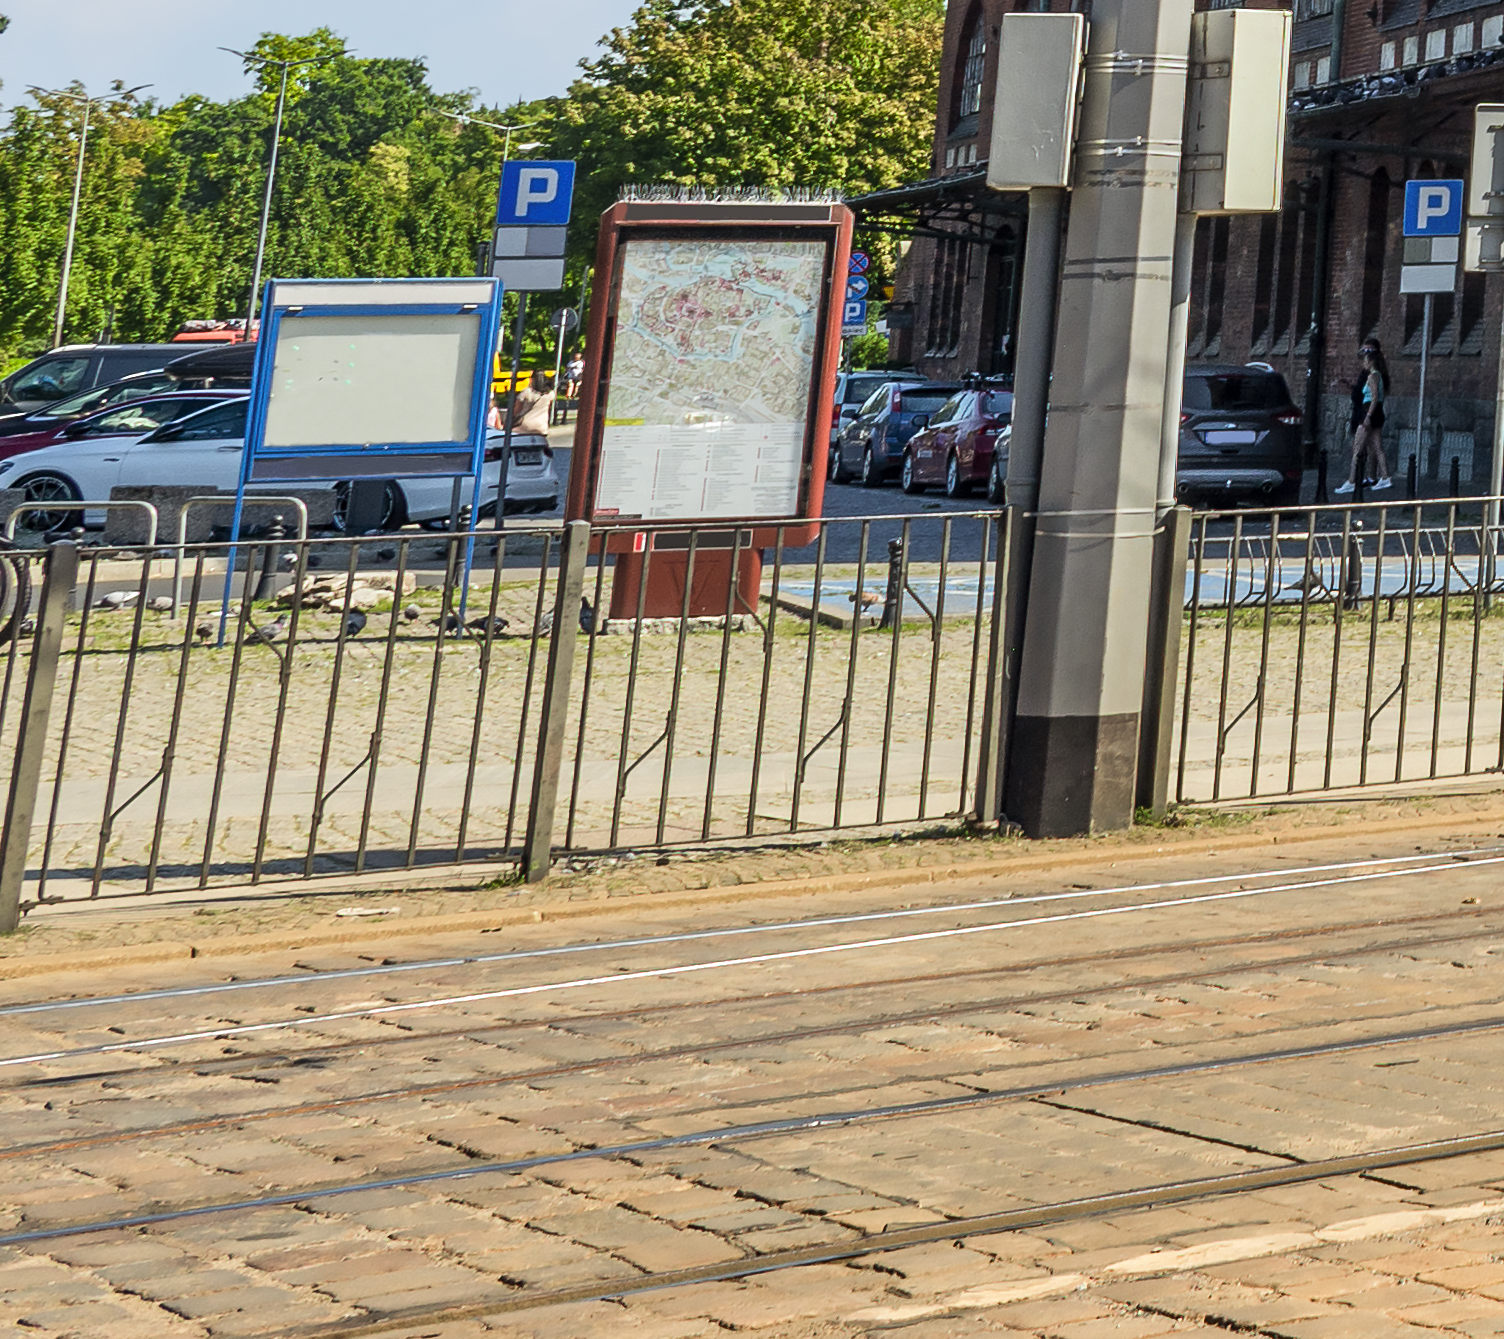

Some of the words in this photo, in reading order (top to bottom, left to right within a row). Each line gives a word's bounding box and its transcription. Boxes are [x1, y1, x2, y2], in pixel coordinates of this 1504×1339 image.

[514, 168, 558, 216] P
[1417, 186, 1450, 229] P
[845, 302, 861, 322] P
